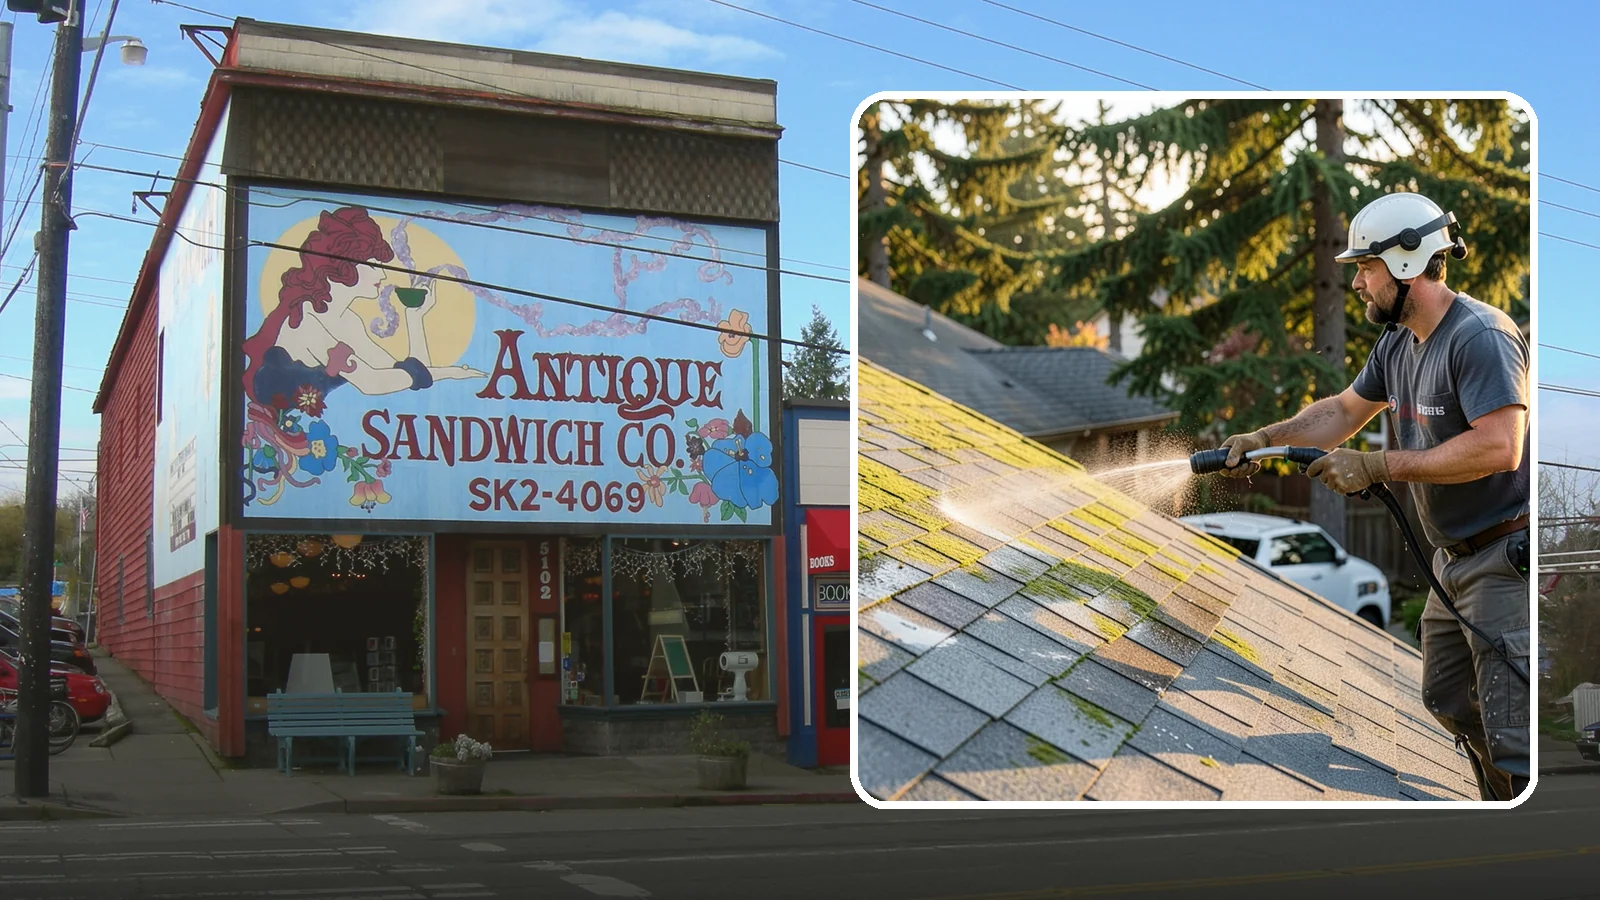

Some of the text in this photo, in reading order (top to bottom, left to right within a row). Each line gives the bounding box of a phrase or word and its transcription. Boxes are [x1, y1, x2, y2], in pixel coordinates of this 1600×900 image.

[475, 329, 724, 421] ANTIQUE
[361, 408, 684, 468] SANDWICH CO.
[468, 477, 646, 513] SK2-4069
[540, 542, 551, 599] 5102
[809, 555, 835, 569] BOOKS
